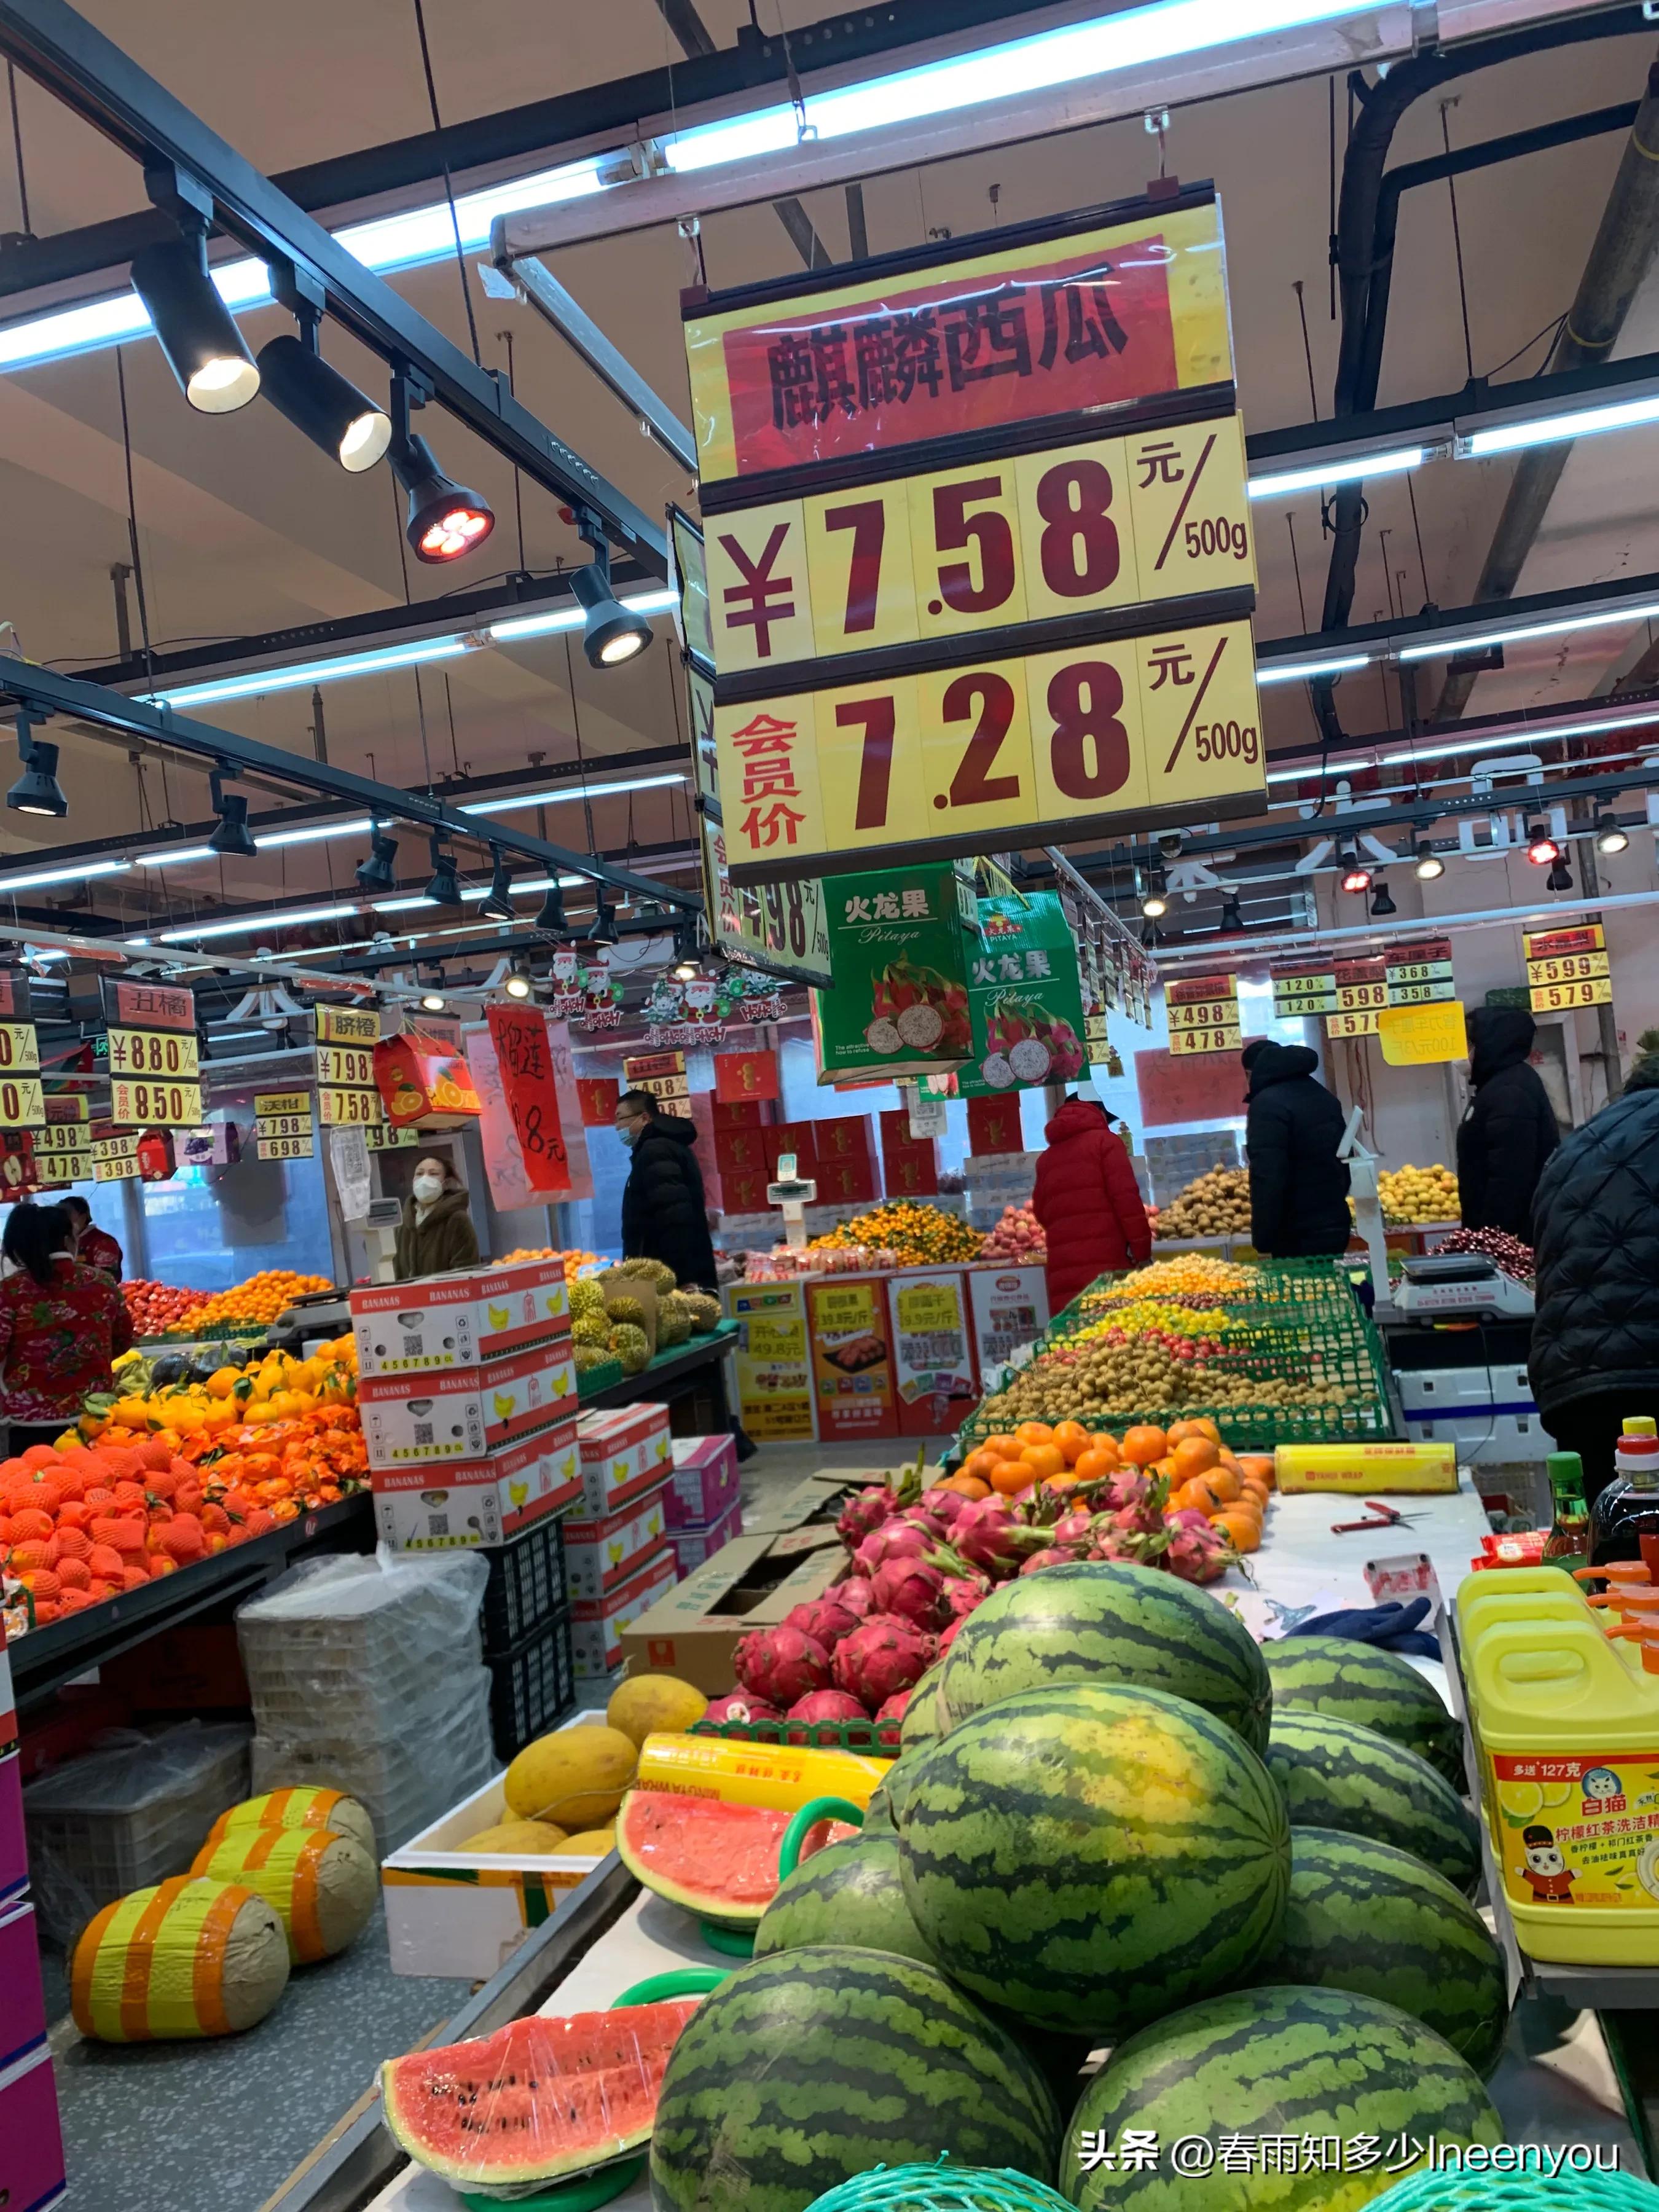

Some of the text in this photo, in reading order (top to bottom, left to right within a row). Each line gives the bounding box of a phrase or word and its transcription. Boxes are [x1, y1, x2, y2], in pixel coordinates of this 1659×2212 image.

[769, 262, 1129, 431] 麒麟西瓜
[732, 714, 805, 849] 会员价
[835, 662, 1131, 830] 7.28
[845, 889, 929, 922] 火龙果
[858, 925, 920, 945] Pitaya
[972, 950, 1051, 986] 火龙果
[130, 989, 186, 1016] 丑橘
[985, 988, 1043, 1007] Pitaya
[335, 1016, 376, 1037] 脐橙
[117, 1084, 130, 1119] 会员价
[135, 1085, 182, 1120] 8.50
[335, 1094, 369, 1121] 7.58
[362, 1288, 470, 1309] BANANAS BANANAS
[372, 1378, 479, 1398] BANANAS BANANAS
[384, 1468, 496, 1488] BANANAS BANANAS
[1513, 1762, 1582, 1778] 多送 127克
[1582, 1795, 1626, 1817] 白猫
[1556, 1814, 1659, 1842] 柠檬红茶洗洁精
